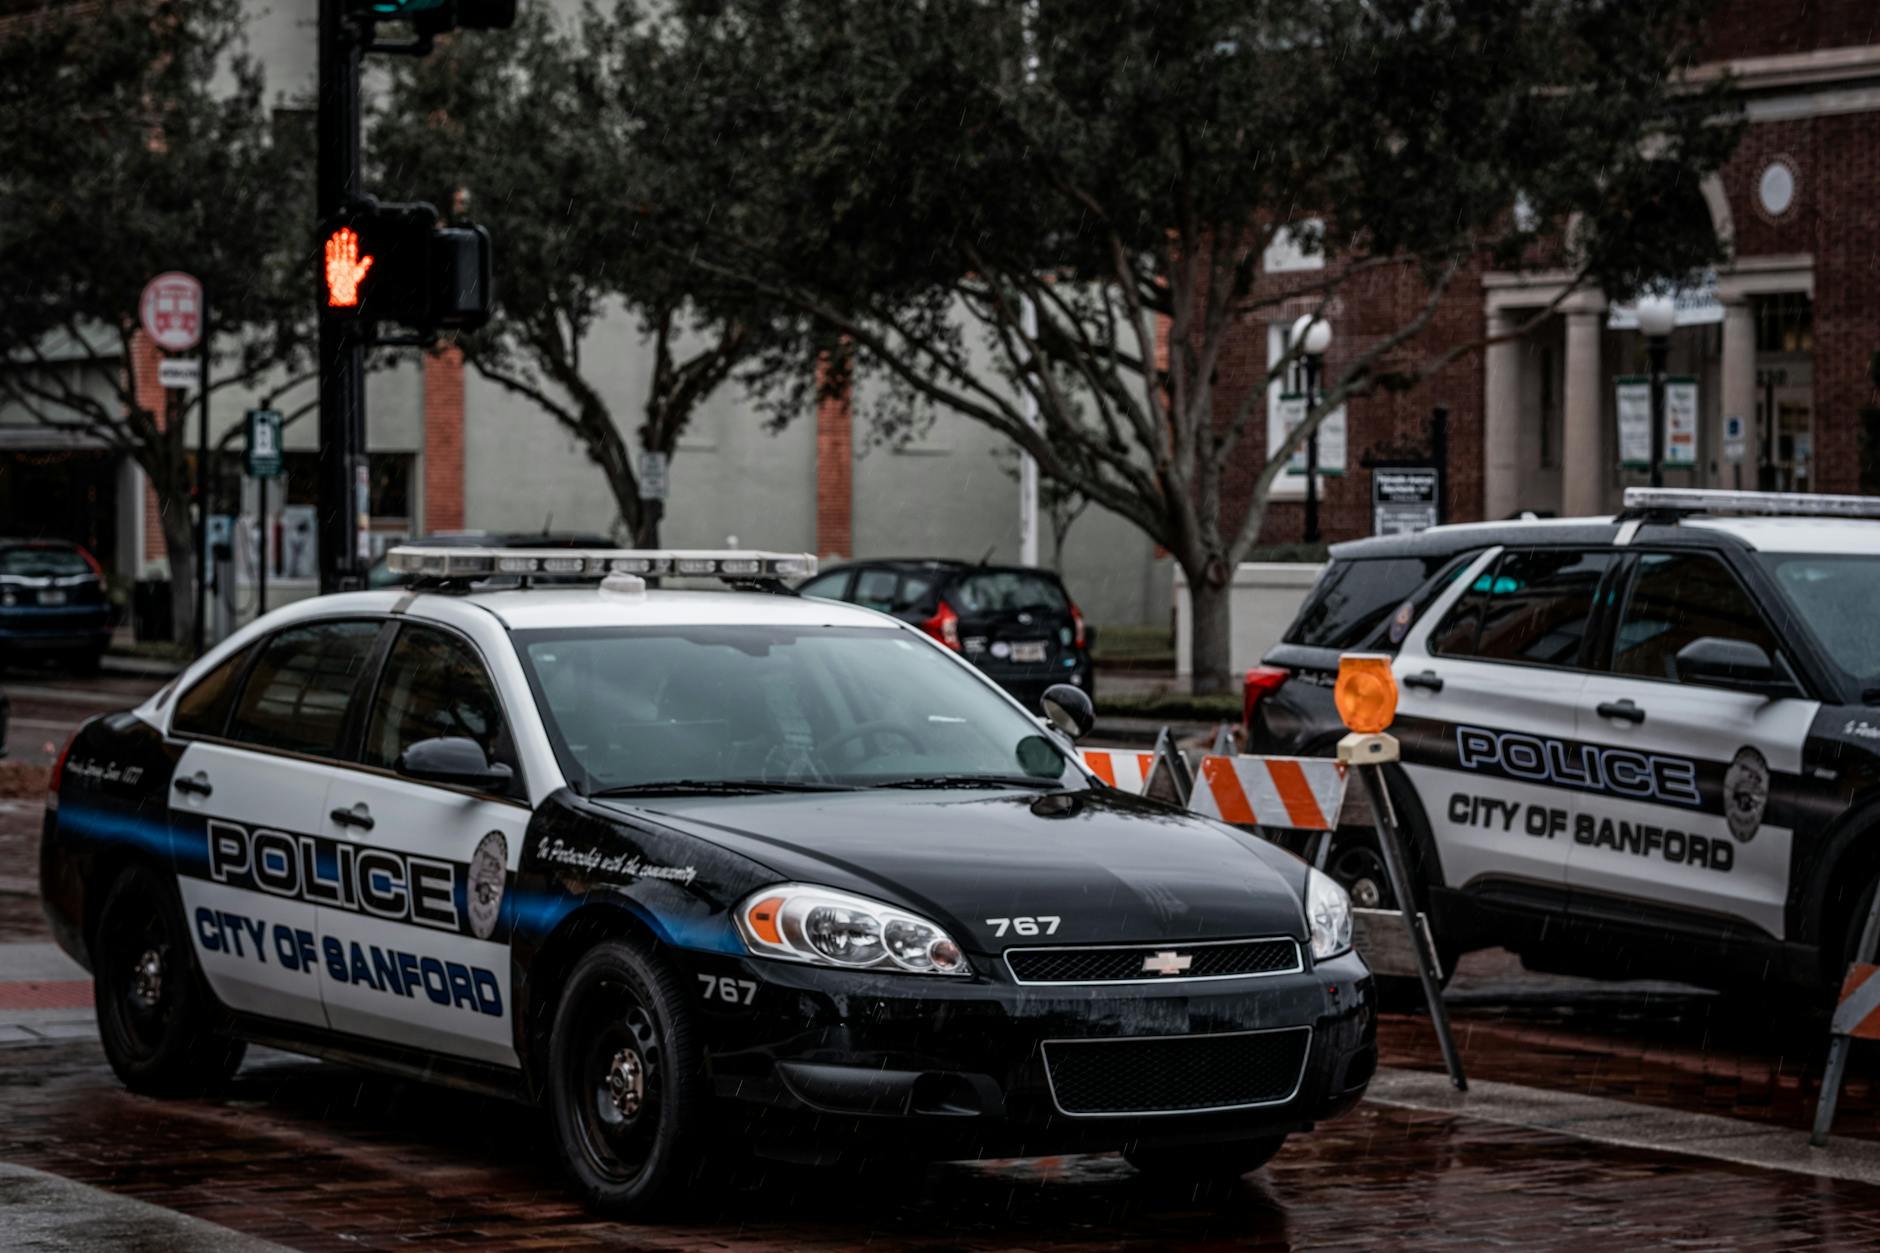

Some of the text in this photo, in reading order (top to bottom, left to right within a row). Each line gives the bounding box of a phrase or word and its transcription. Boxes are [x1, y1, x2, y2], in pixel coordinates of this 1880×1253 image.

[1456, 725, 1701, 805] POLICE
[536, 836, 550, 859] In
[600, 852, 628, 872] with
[621, 855, 641, 875] the
[1448, 792, 1735, 873] CITY OF SANFORD
[207, 819, 460, 931] POLICE
[195, 906, 504, 1018] CITY OF SANFORD
[986, 916, 1061, 937] 767
[698, 973, 757, 1005] 767
